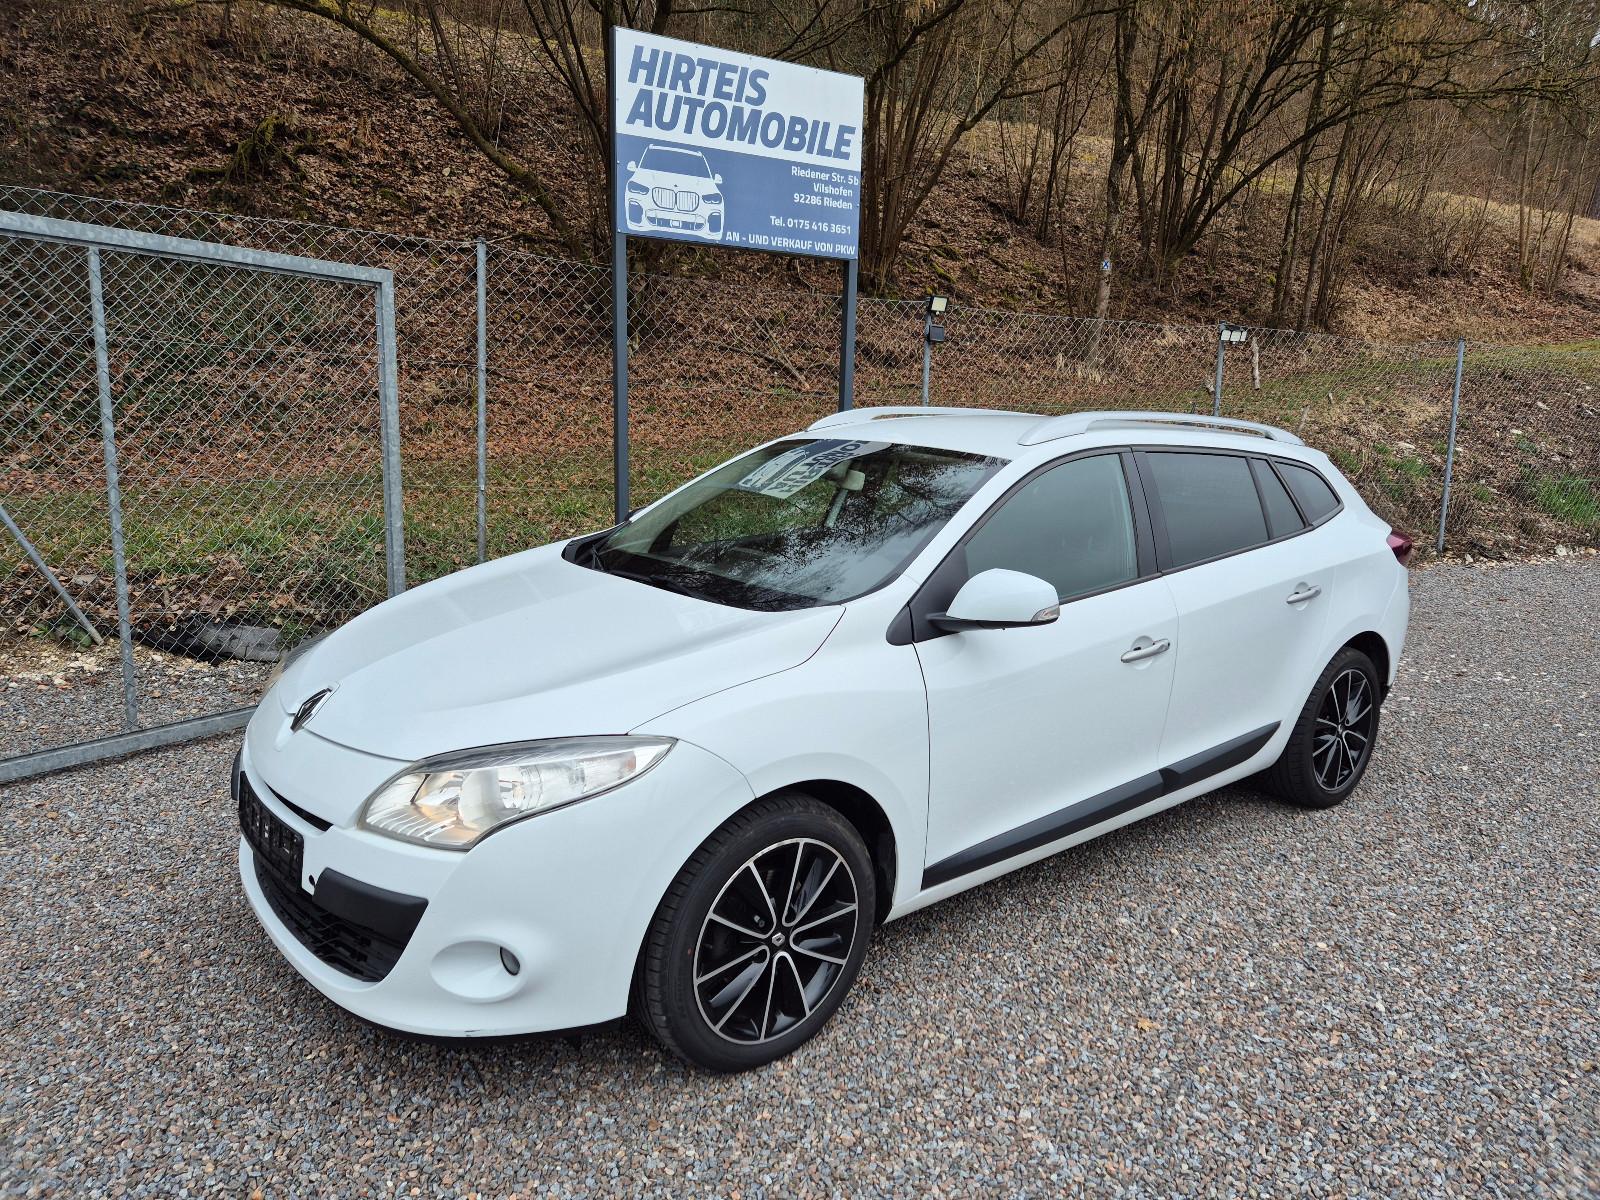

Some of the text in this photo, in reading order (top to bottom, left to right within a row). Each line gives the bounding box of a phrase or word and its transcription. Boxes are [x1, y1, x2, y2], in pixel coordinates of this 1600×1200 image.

[628, 45, 769, 106] HIRTEIS
[626, 88, 856, 160] AUTOMOBILE
[791, 166, 859, 185] Riedener Str. 5b
[813, 182, 853, 197] Vilshofen
[793, 193, 853, 210] 92286 Rieden
[770, 215, 851, 235] Tel. 0175 416 3651
[726, 231, 740, 242] AN
[748, 234, 769, 245] UND
[770, 236, 813, 250] VERKAUF
[814, 243, 833, 253] VON
[835, 244, 856, 255] PKW
